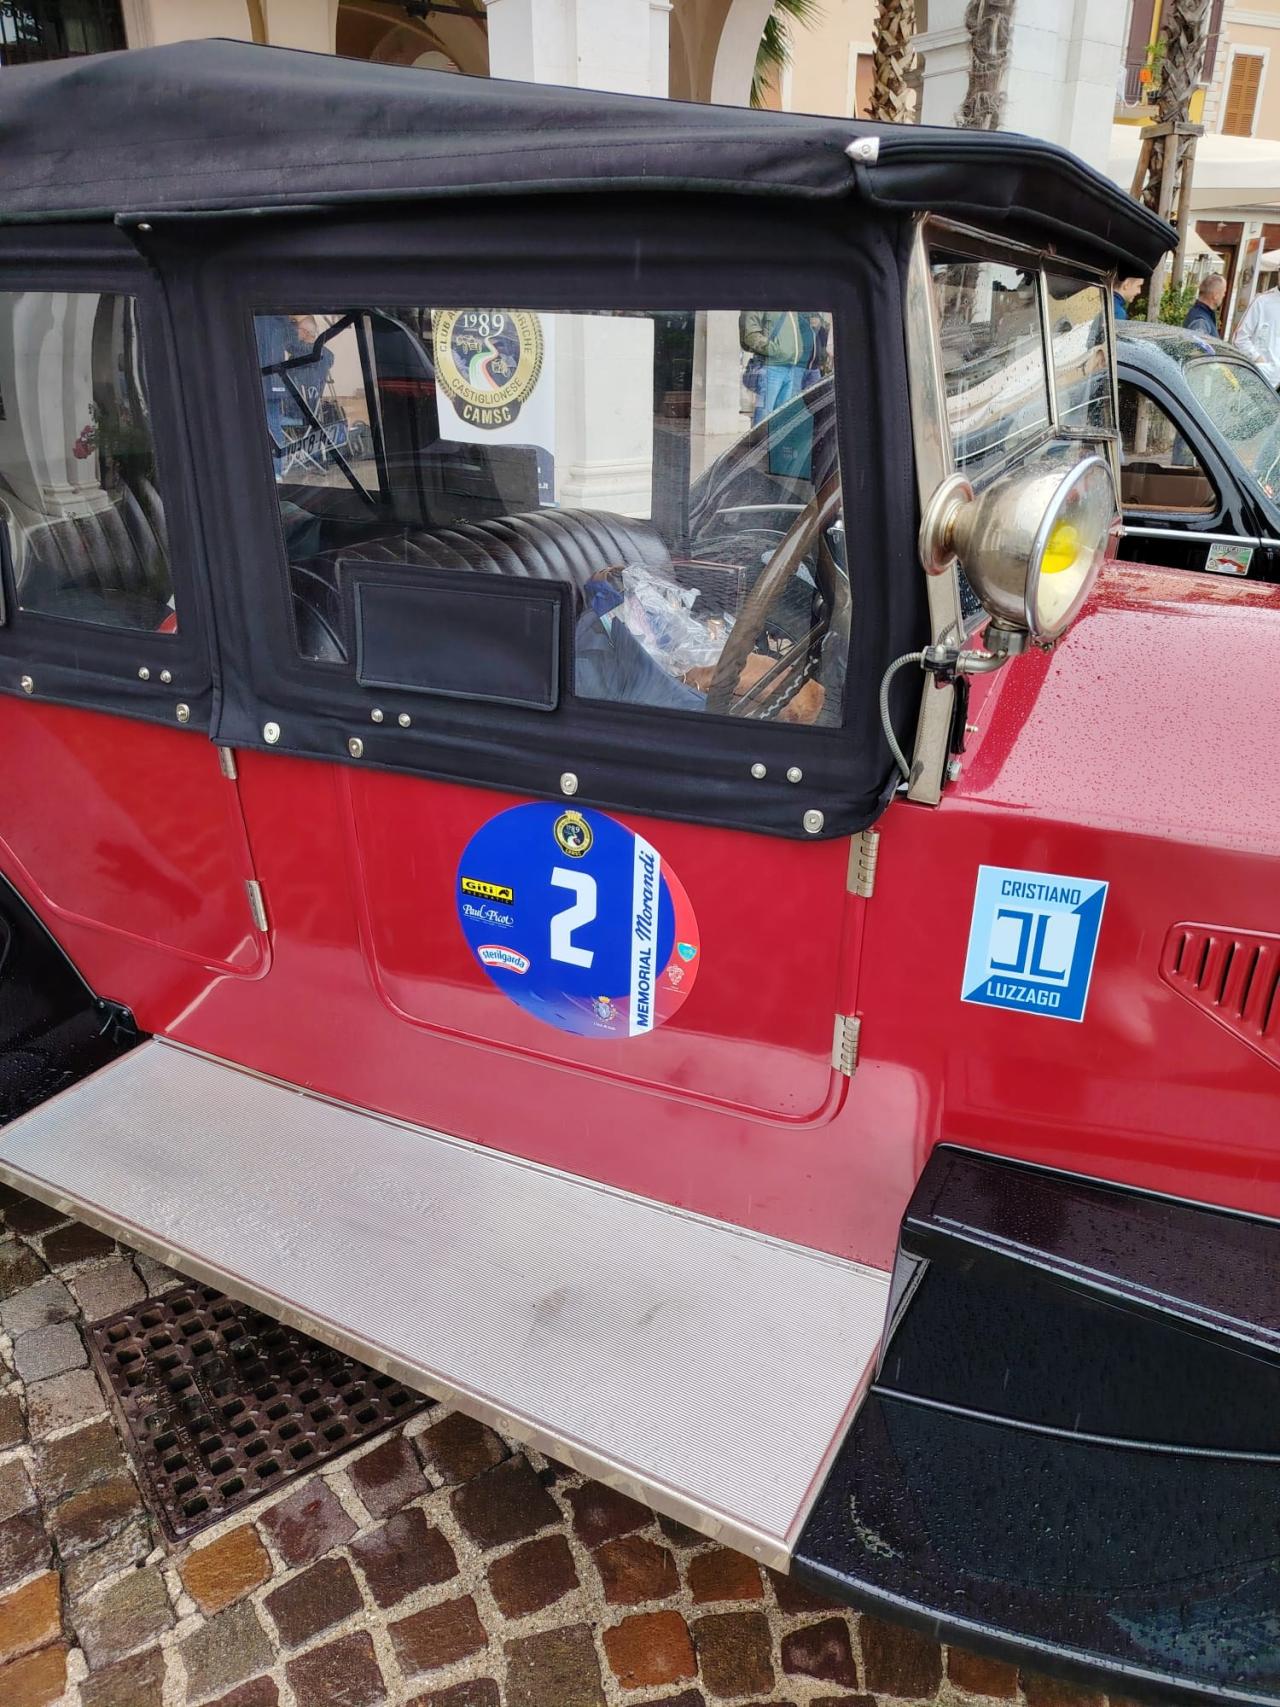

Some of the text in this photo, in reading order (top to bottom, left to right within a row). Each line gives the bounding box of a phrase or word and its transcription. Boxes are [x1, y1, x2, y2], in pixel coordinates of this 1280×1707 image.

[440, 321, 451, 352] CLUB
[463, 313, 505, 338] 1989
[451, 378, 522, 405] CASTIGLIONESE
[463, 404, 512, 425] CAMSC
[465, 881, 494, 895] Giti
[1001, 880, 1082, 905] CRISTIANO
[463, 903, 487, 919] Paul
[486, 909, 514, 926] Picot
[550, 866, 598, 969] 2
[634, 852, 656, 1027] MEMORIAL Morandi
[482, 949, 525, 969] sterilgarda
[986, 981, 1061, 1008] LUZZAGO
